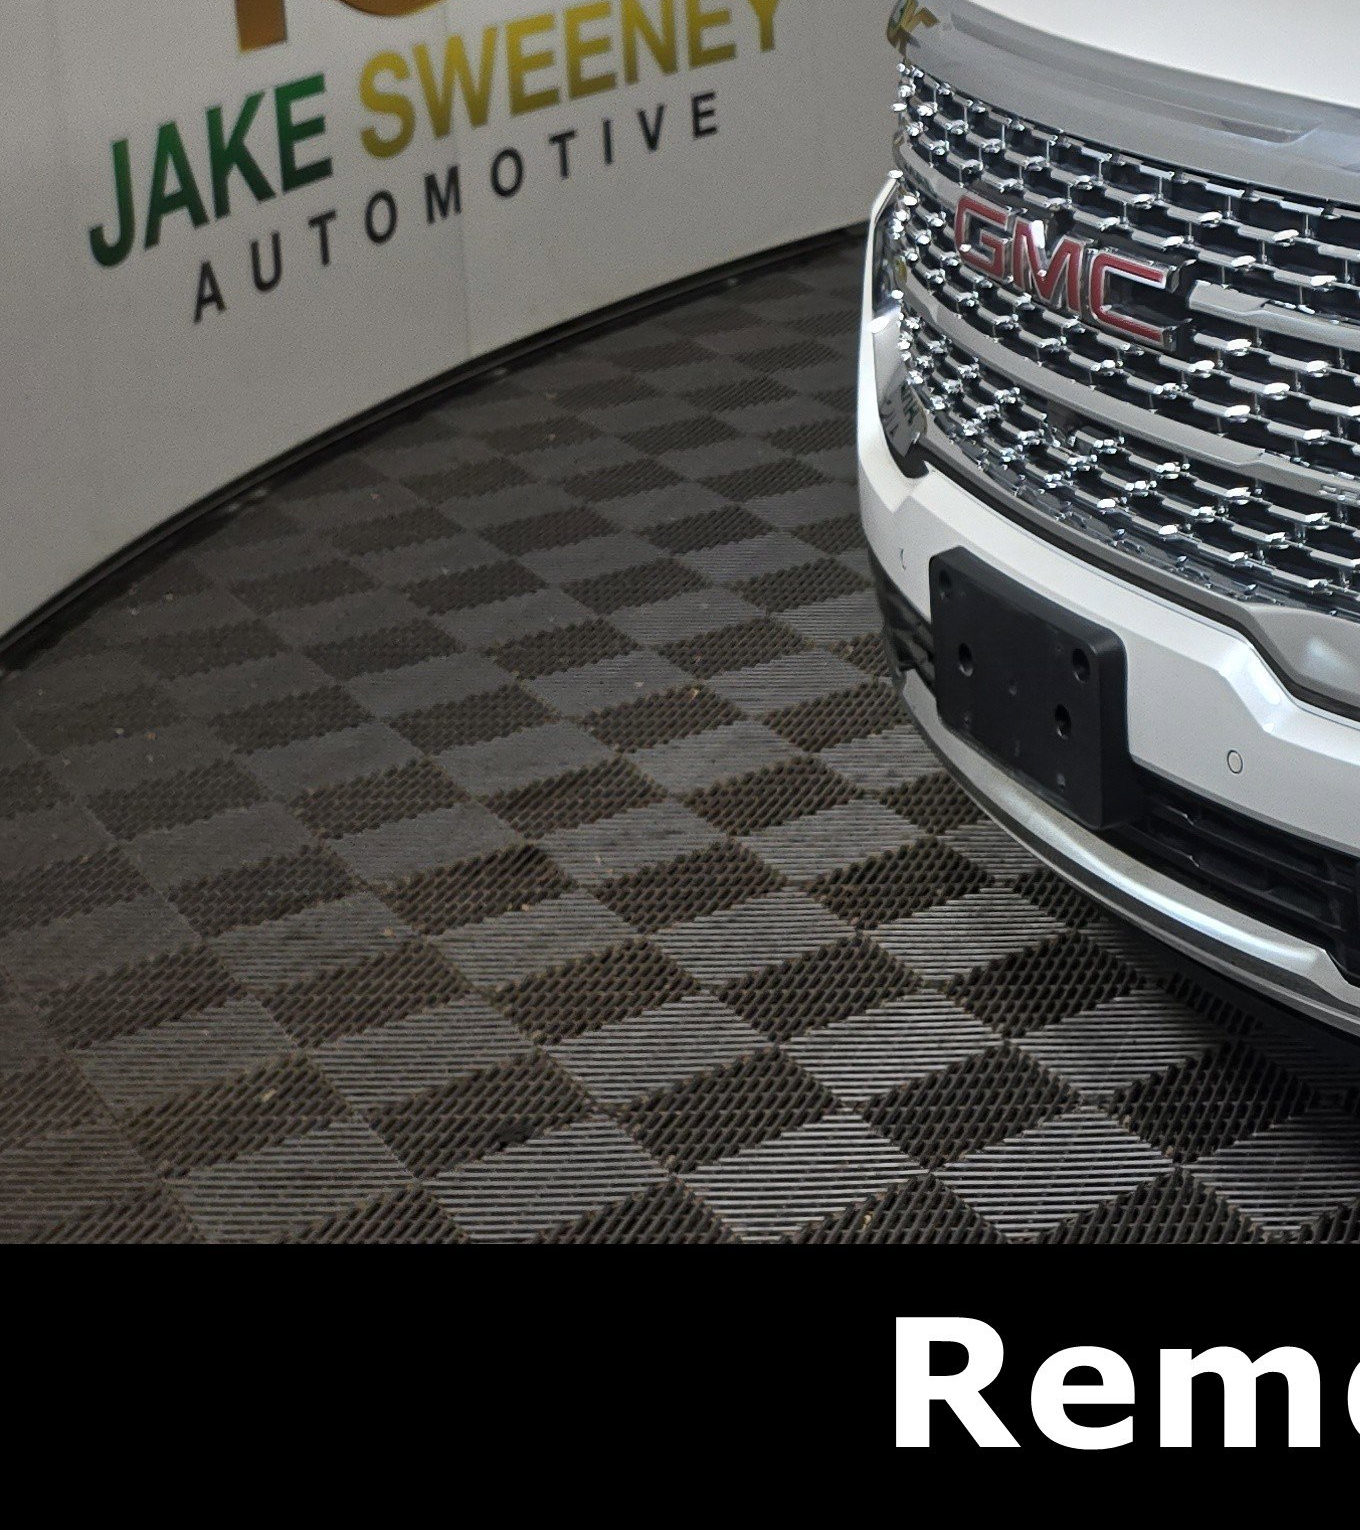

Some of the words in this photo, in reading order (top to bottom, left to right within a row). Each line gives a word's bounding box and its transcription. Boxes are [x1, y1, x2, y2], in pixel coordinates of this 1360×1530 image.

[88, 73, 333, 268] JAKE
[193, 92, 719, 323] AUTOMOTIVE
[954, 194, 1177, 351] GMC
